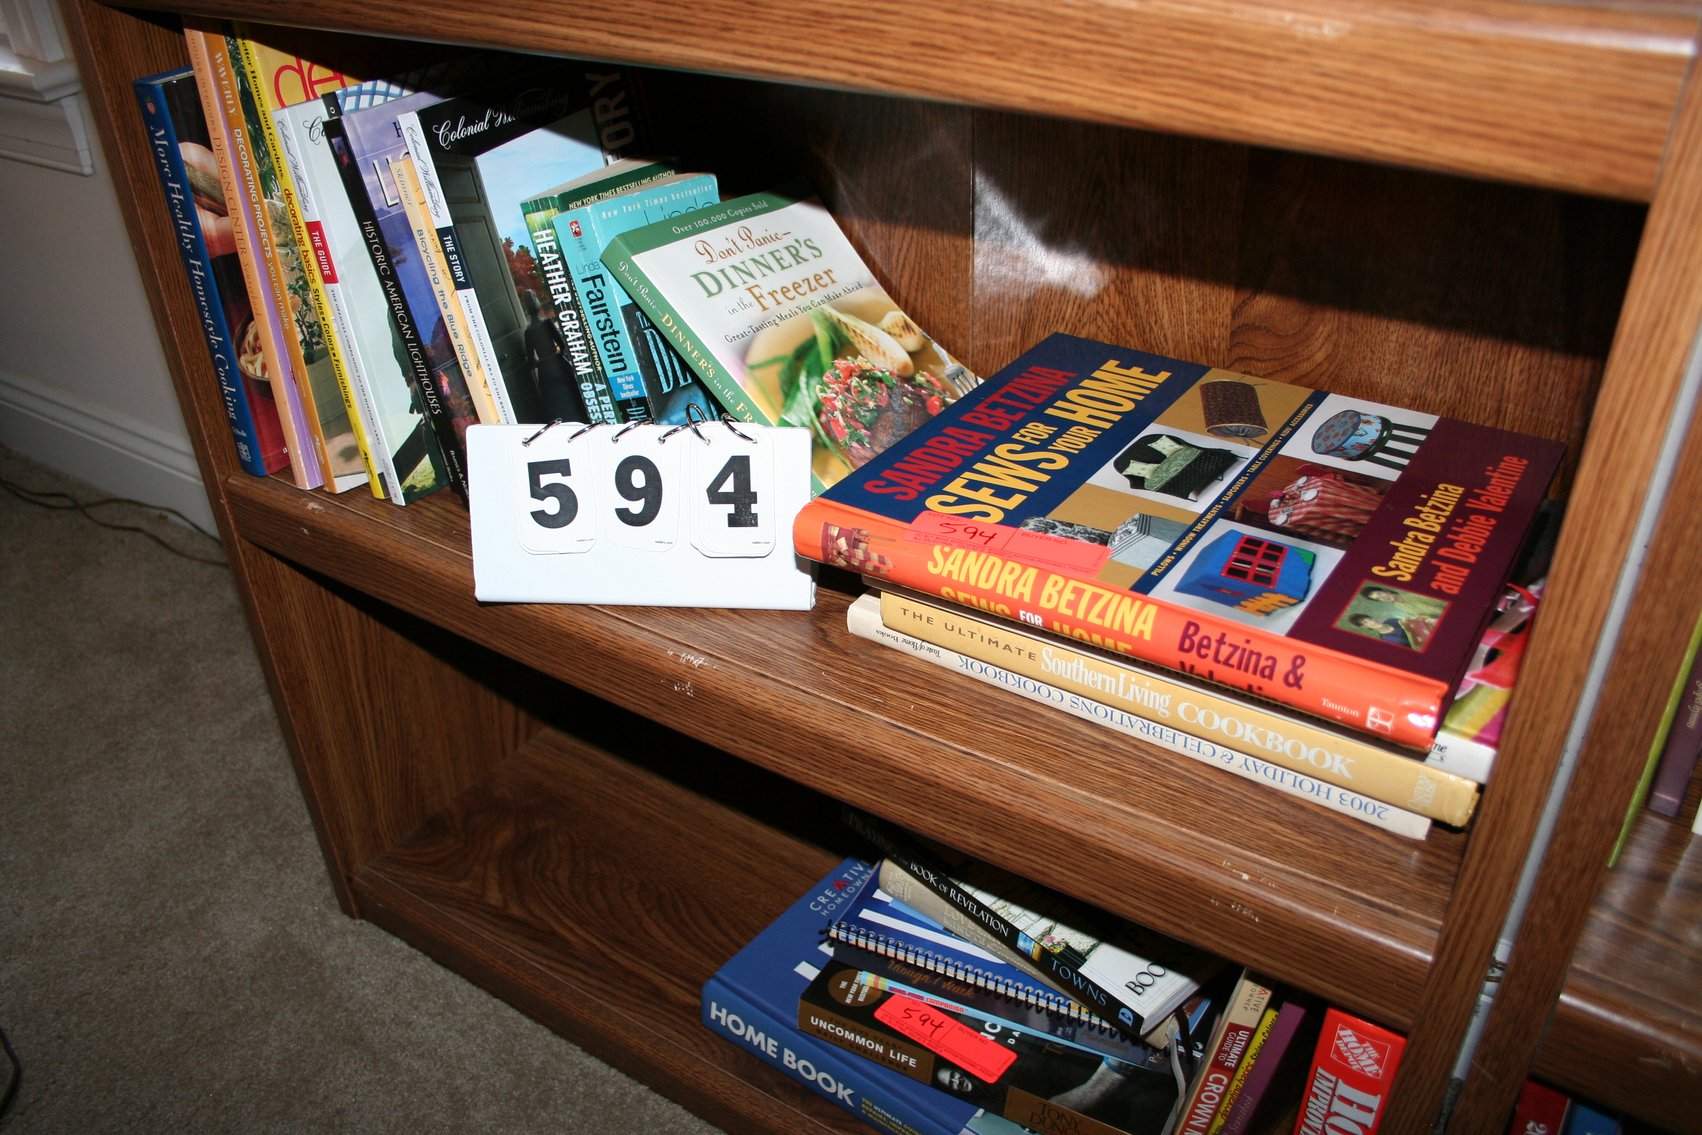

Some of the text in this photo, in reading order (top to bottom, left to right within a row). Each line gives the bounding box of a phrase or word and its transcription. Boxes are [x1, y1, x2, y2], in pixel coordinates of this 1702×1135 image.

[250, 70, 262, 107] Homes
[262, 110, 271, 130] and
[432, 108, 491, 150] Colonial
[216, 53, 289, 331] WAVERLY DECORATING PROJECTS you can make
[277, 119, 312, 212] Colonial Williamsburg
[397, 168, 412, 206] Skinner
[406, 126, 426, 165] Colonial
[420, 166, 440, 218] Williamsburg
[567, 168, 676, 210] NEW YORK TIMES BESTSELLING AUTHOR
[213, 138, 232, 191] DESIGN
[228, 197, 248, 254] CENTER
[602, 210, 617, 218] New
[622, 202, 640, 213] York
[645, 196, 667, 207] Times
[671, 185, 713, 200] bestseller
[672, 225, 692, 234] Over
[694, 212, 726, 227] 100,000
[726, 202, 753, 220] Copies
[752, 198, 768, 211] Sold
[151, 127, 236, 419] More Healthy Homestyle Cooking
[312, 231, 331, 278] THE GUIDE
[442, 233, 466, 284] THE STORY
[575, 260, 601, 275] Linda
[690, 238, 823, 299] DINNER'S
[695, 238, 742, 262] Don't
[284, 187, 354, 408] decorating basics Styles Colors Furnishings
[417, 229, 472, 376] Bicycling the Blue Ridge
[536, 228, 593, 376] HEATHER GRAHAM
[724, 282, 862, 343] Great-Tasting Meals You Can Make Ahead
[726, 295, 755, 316] in the
[746, 267, 838, 312] Freezer
[336, 304, 346, 332] OFFICIAL
[345, 335, 358, 373] COMPANION
[364, 221, 389, 274] HISTORIC
[386, 281, 413, 338] AMERICAN
[408, 343, 440, 414] LIGHTHOUSES
[464, 296, 472, 313] FROM
[476, 329, 488, 361] COLONIAL
[581, 273, 628, 373] Fairstein
[619, 261, 638, 286] Don't
[714, 378, 721, 388] in
[722, 389, 734, 402] the
[589, 340, 602, 372] AUTHOR
[594, 383, 607, 392] A
[1044, 359, 1172, 430] HOME
[863, 365, 1078, 500] SANDRA BETZINA
[1011, 421, 1059, 445] FOR
[1048, 426, 1102, 454] YOUR
[925, 443, 1071, 524] SEWS
[1150, 401, 1314, 578] PILLOWS WINDOW TREATMENTS SLIPCOVERS TABLE COVERINGS ACCESSORIES
[939, 522, 997, 545] 594
[1371, 483, 1465, 582] Sandra Betzina
[1430, 455, 1528, 595] and Debbie Valentine
[927, 545, 1040, 603] SANDRA
[1040, 570, 1159, 641] BETZINA
[1019, 609, 1043, 628] FOR
[876, 630, 898, 642] Books
[900, 607, 1037, 662] THE ULTIMATE
[902, 637, 920, 650] Home
[925, 646, 942, 658] Taste
[1177, 620, 1278, 682] Betzina
[1282, 654, 1307, 690] &
[1320, 697, 1361, 719] Taunton
[959, 654, 1387, 819] 2003 HOLIDAY & CELEBRATIONS COOKBOOK
[1176, 700, 1357, 780] COOKBOOK
[910, 864, 936, 884] BOOK
[950, 889, 1008, 936] REVELATION
[1052, 958, 1106, 1005] TOWNS
[811, 1017, 882, 1052] UNCOMMON
[888, 1050, 916, 1067] LIFE
[901, 1008, 945, 1038] 594
[1216, 1030, 1237, 1062] GUIDE TO
[1223, 1028, 1249, 1070] ULTIMATE
[1361, 1041, 1381, 1059] THE
[710, 1002, 778, 1059] HOME
[782, 1048, 856, 1108] BOOK
[1335, 1039, 1362, 1070] DEPOT
[1338, 1028, 1383, 1077] HOME
[1038, 1102, 1083, 1130] TONY
[1188, 1070, 1229, 1132] CROWN
[1217, 1082, 1241, 1120] decorating
[1236, 1060, 1252, 1084] basics
